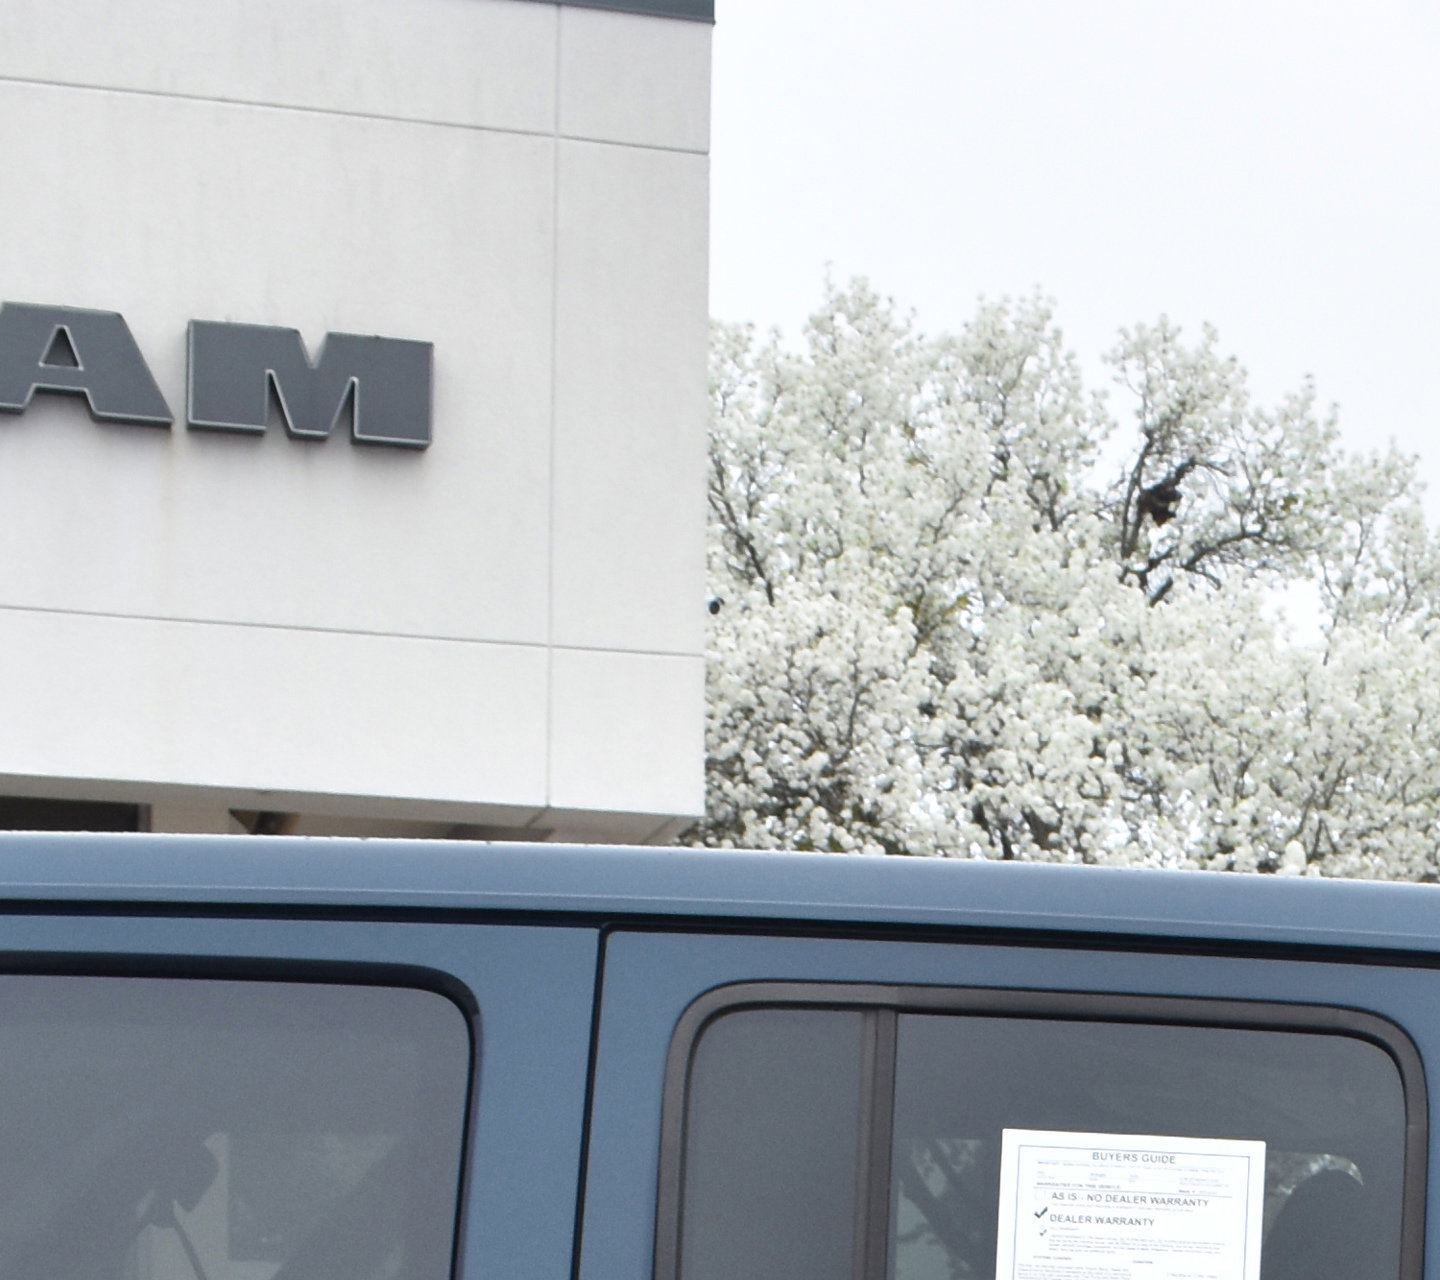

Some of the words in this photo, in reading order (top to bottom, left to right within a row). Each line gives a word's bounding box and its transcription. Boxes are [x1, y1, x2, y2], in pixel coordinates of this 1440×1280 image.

[1092, 1151, 1139, 1163] BUYERS
[1141, 1153, 1176, 1165] GUIDE
[1086, 1193, 1103, 1203] NO
[1105, 1194, 1147, 1205] DEALER
[1149, 1196, 1210, 1208] WARRANTY
[1049, 1213, 1092, 1225] DEALER
[1094, 1215, 1156, 1228] WARRANTY
